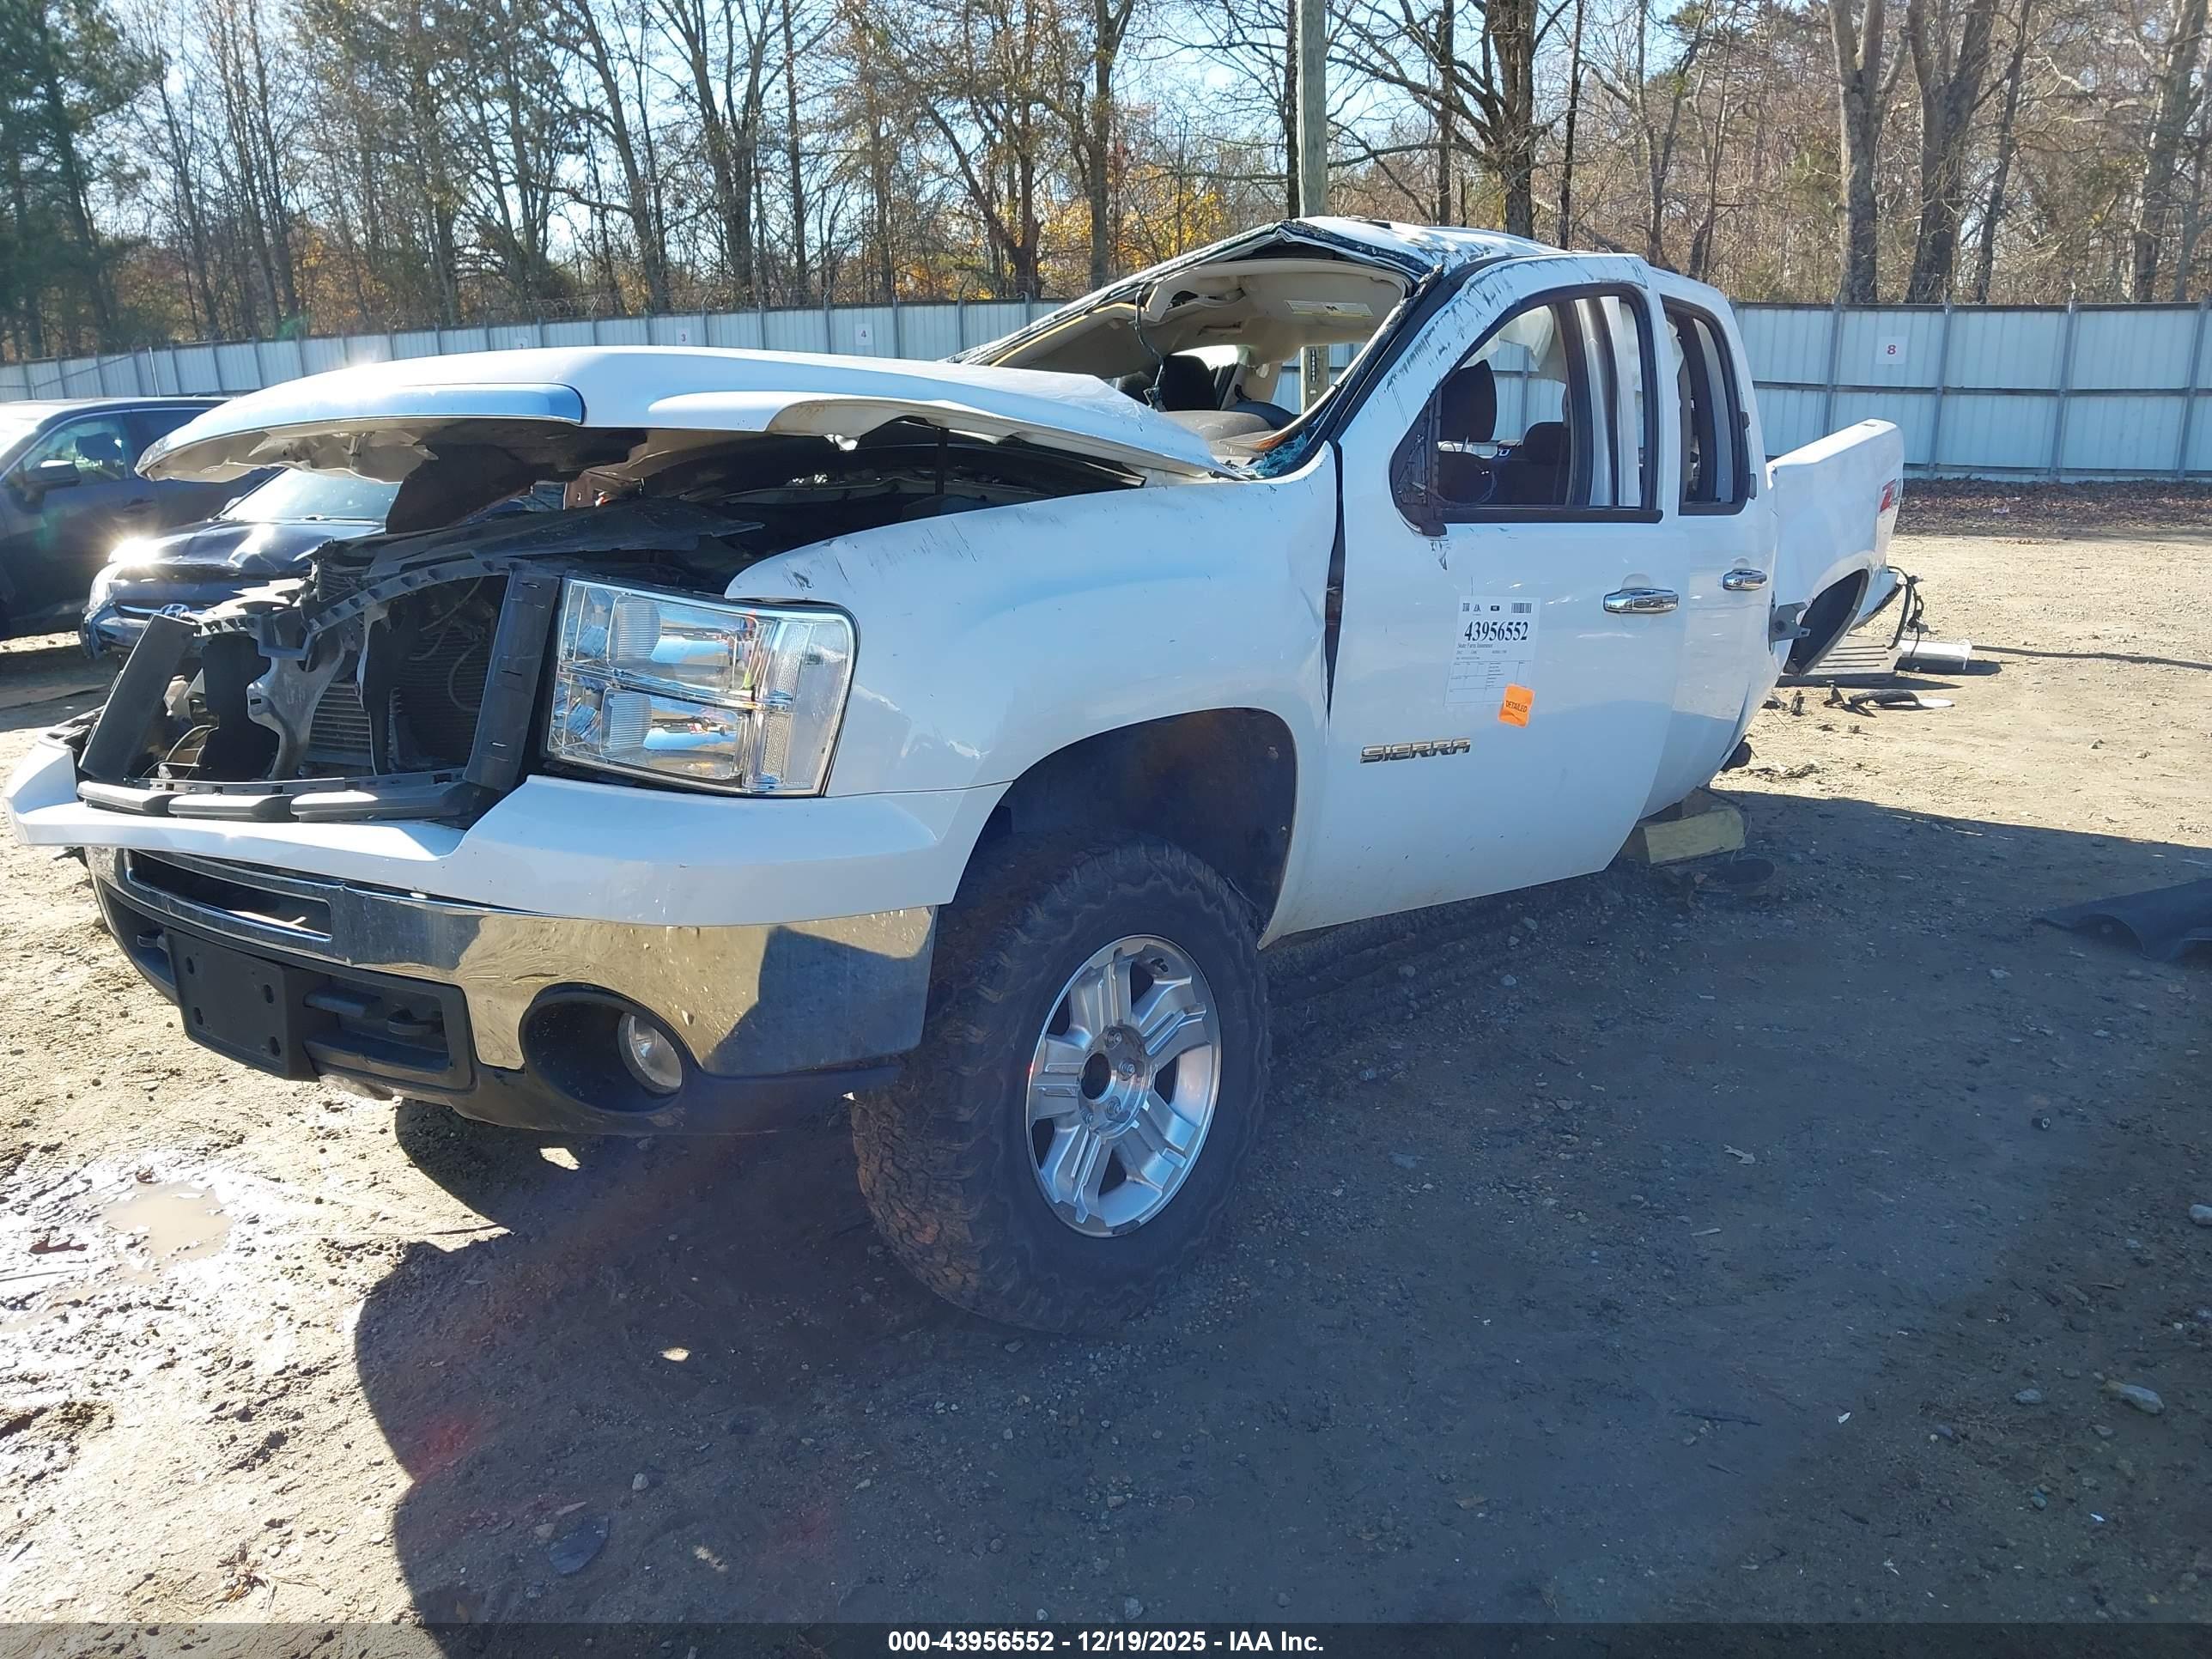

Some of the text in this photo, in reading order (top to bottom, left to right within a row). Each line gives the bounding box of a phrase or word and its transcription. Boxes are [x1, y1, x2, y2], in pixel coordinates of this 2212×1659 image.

[681, 333, 686, 342] 3
[860, 329, 867, 338] 4
[1887, 344, 1896, 356] 8
[1464, 620, 1528, 641] 43956552
[1505, 700, 1528, 713] DETAILED
[1360, 737, 1471, 763] SIERRA
